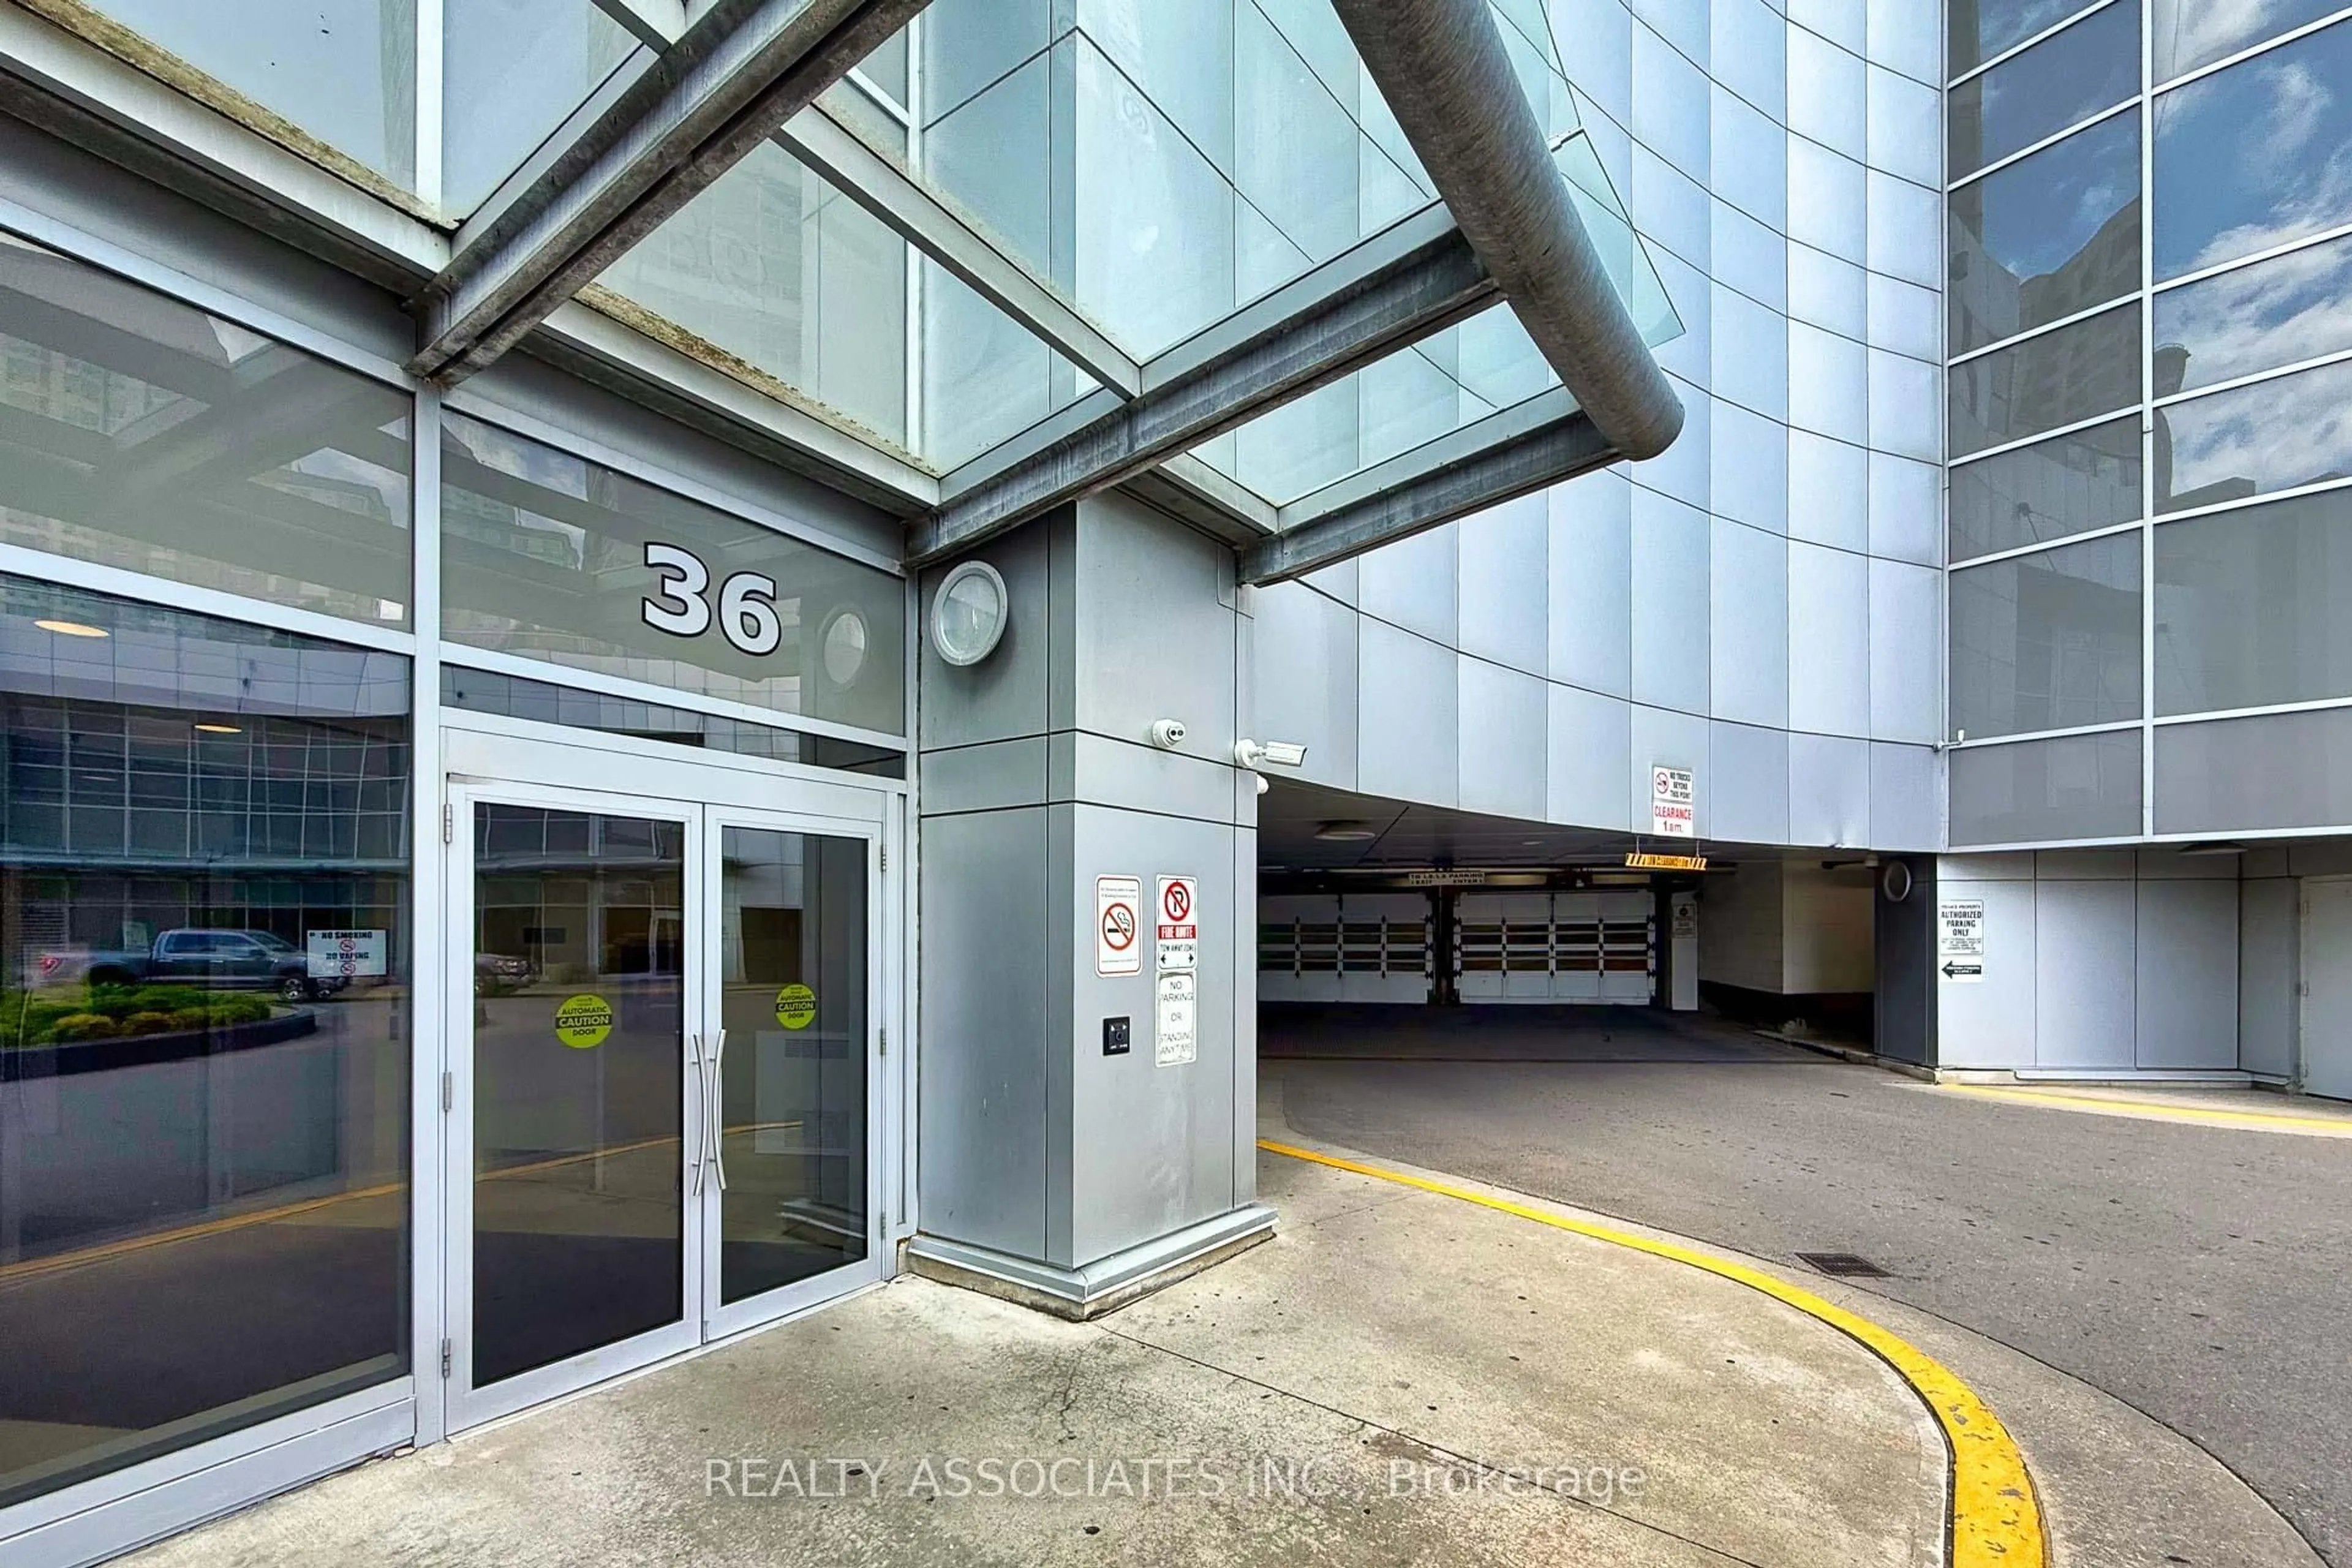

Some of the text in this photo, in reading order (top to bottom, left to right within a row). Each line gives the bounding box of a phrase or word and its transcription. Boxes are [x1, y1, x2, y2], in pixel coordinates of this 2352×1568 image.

[642, 541, 782, 657] 36
[1655, 805, 1692, 820] CLEARANCE
[1170, 981, 1182, 990] NO
[562, 1006, 608, 1015] AUTOMATIC
[778, 1001, 813, 1011] CAUTION
[559, 1016, 609, 1027] CAUTION
[1170, 1012, 1182, 1022] OR
